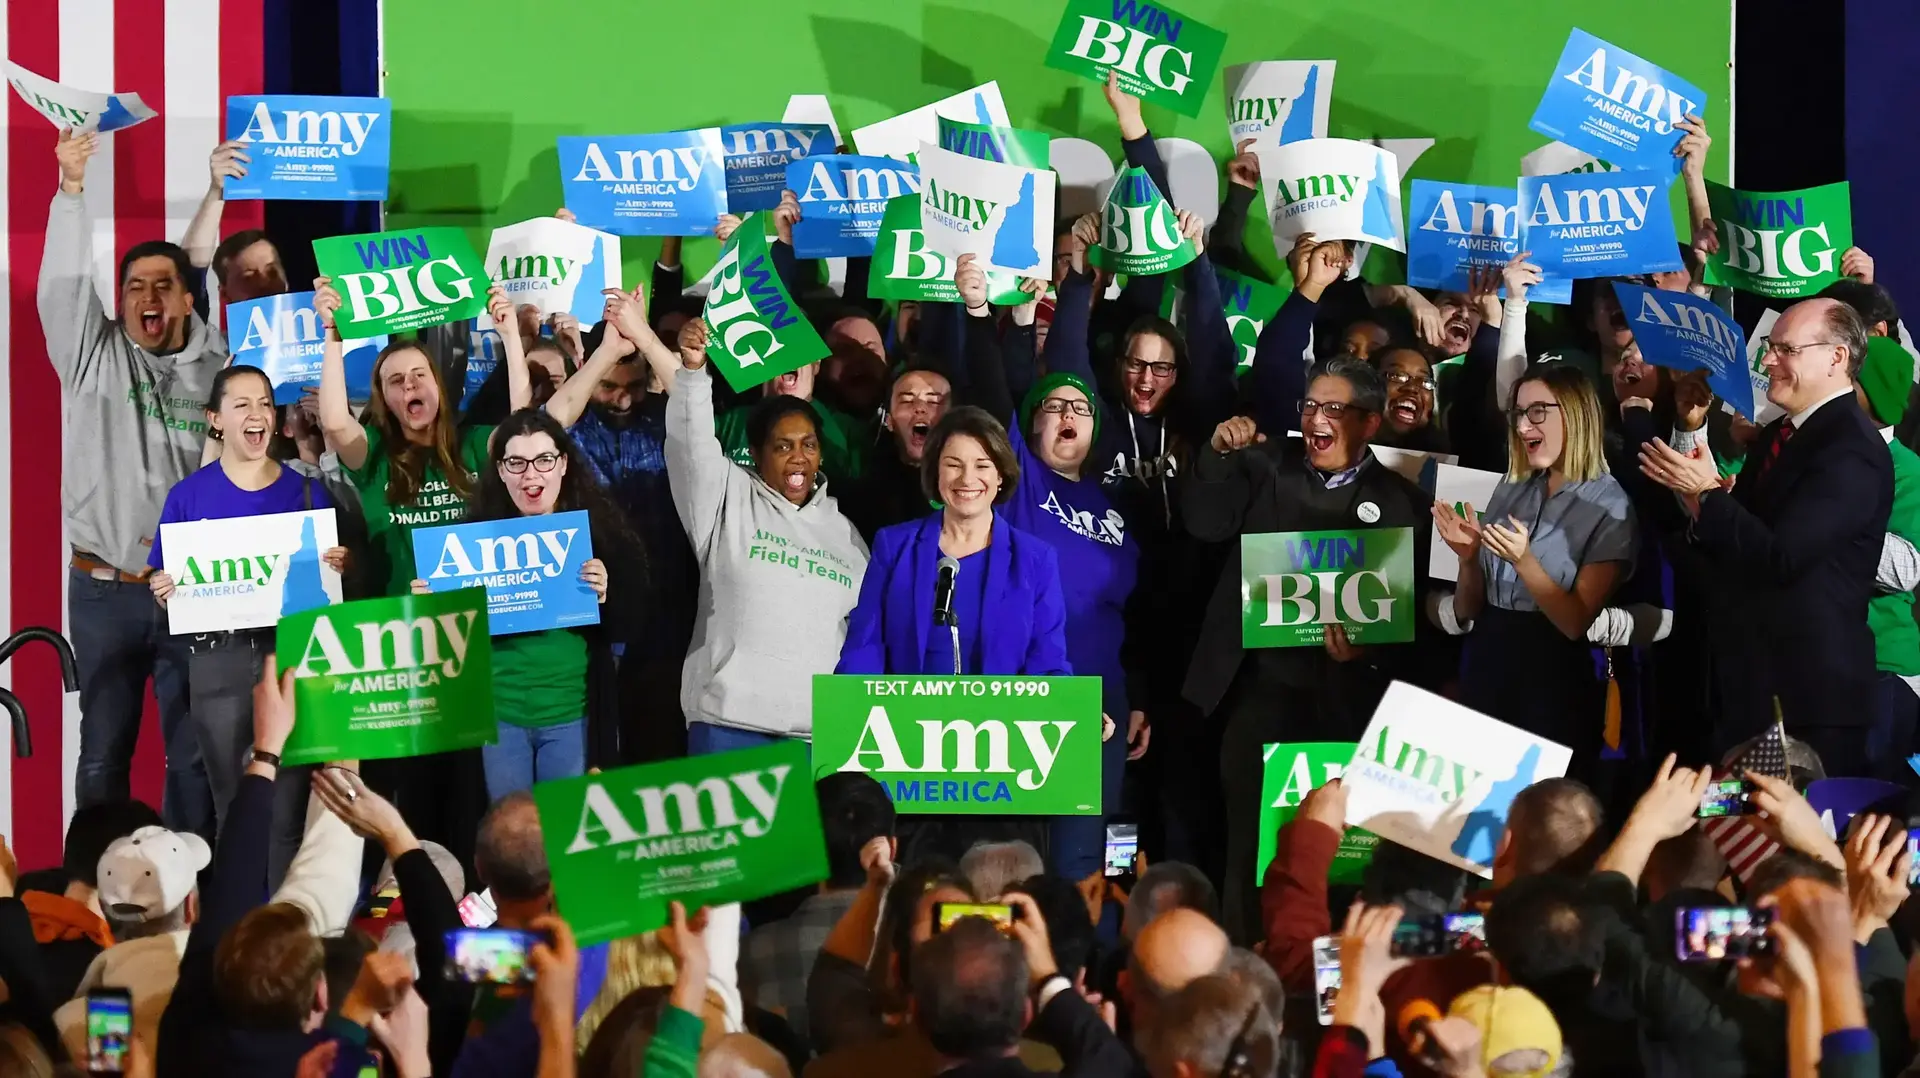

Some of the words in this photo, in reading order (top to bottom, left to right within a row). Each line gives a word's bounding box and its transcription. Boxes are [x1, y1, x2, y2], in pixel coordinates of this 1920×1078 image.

[1111, 0, 1183, 43] WIN
[1065, 15, 1194, 96] BIG
[1564, 48, 1696, 135] Amy
[236, 102, 380, 156] Amy
[1593, 100, 1650, 133] AMERICA
[274, 146, 339, 158] AMERICA
[723, 128, 821, 159] my
[572, 143, 709, 191] Amy
[726, 154, 788, 170] AMERICA
[613, 184, 676, 195] AMERICA
[925, 178, 998, 231] Amy
[1273, 174, 1360, 210] Amy
[1528, 183, 1656, 231] Amy
[933, 213, 970, 235] AMERICA
[1098, 199, 1185, 255] BIG
[1284, 198, 1338, 220] AMERICA
[1420, 190, 1518, 239] Am
[1732, 197, 1805, 228] WIN
[1560, 224, 1624, 240] AMERICA
[1721, 218, 1836, 279] BIG
[354, 235, 431, 269] WIN
[492, 255, 575, 286] Amy
[338, 255, 474, 323] BIG
[698, 239, 785, 369] BIG
[743, 254, 798, 330] WIN
[1635, 292, 1739, 363] Amy
[1676, 329, 1726, 358] AMERICA
[752, 528, 791, 547] Amy
[801, 547, 850, 569] AMERICA
[1067, 524, 1112, 545] AMERICA
[175, 554, 281, 586] Amy
[429, 528, 579, 578] Amy
[749, 545, 799, 569] Field
[805, 559, 853, 589] Team
[1285, 536, 1365, 570] WIN
[192, 584, 255, 599] AMERICA
[473, 571, 542, 588] AMERICA
[514, 590, 539, 600] 91990
[1259, 567, 1397, 627] BIG
[294, 610, 478, 678] Amy
[350, 669, 440, 694] AMERICA
[864, 680, 909, 695] TEXT
[912, 680, 956, 695] AMY
[960, 680, 986, 696] TO
[990, 681, 1050, 696] 91990
[837, 705, 1077, 790] Amy
[1360, 725, 1483, 803] Amy
[879, 780, 1012, 801] AMERICA
[565, 765, 792, 855] Amy
[633, 830, 740, 861] AMERICA
